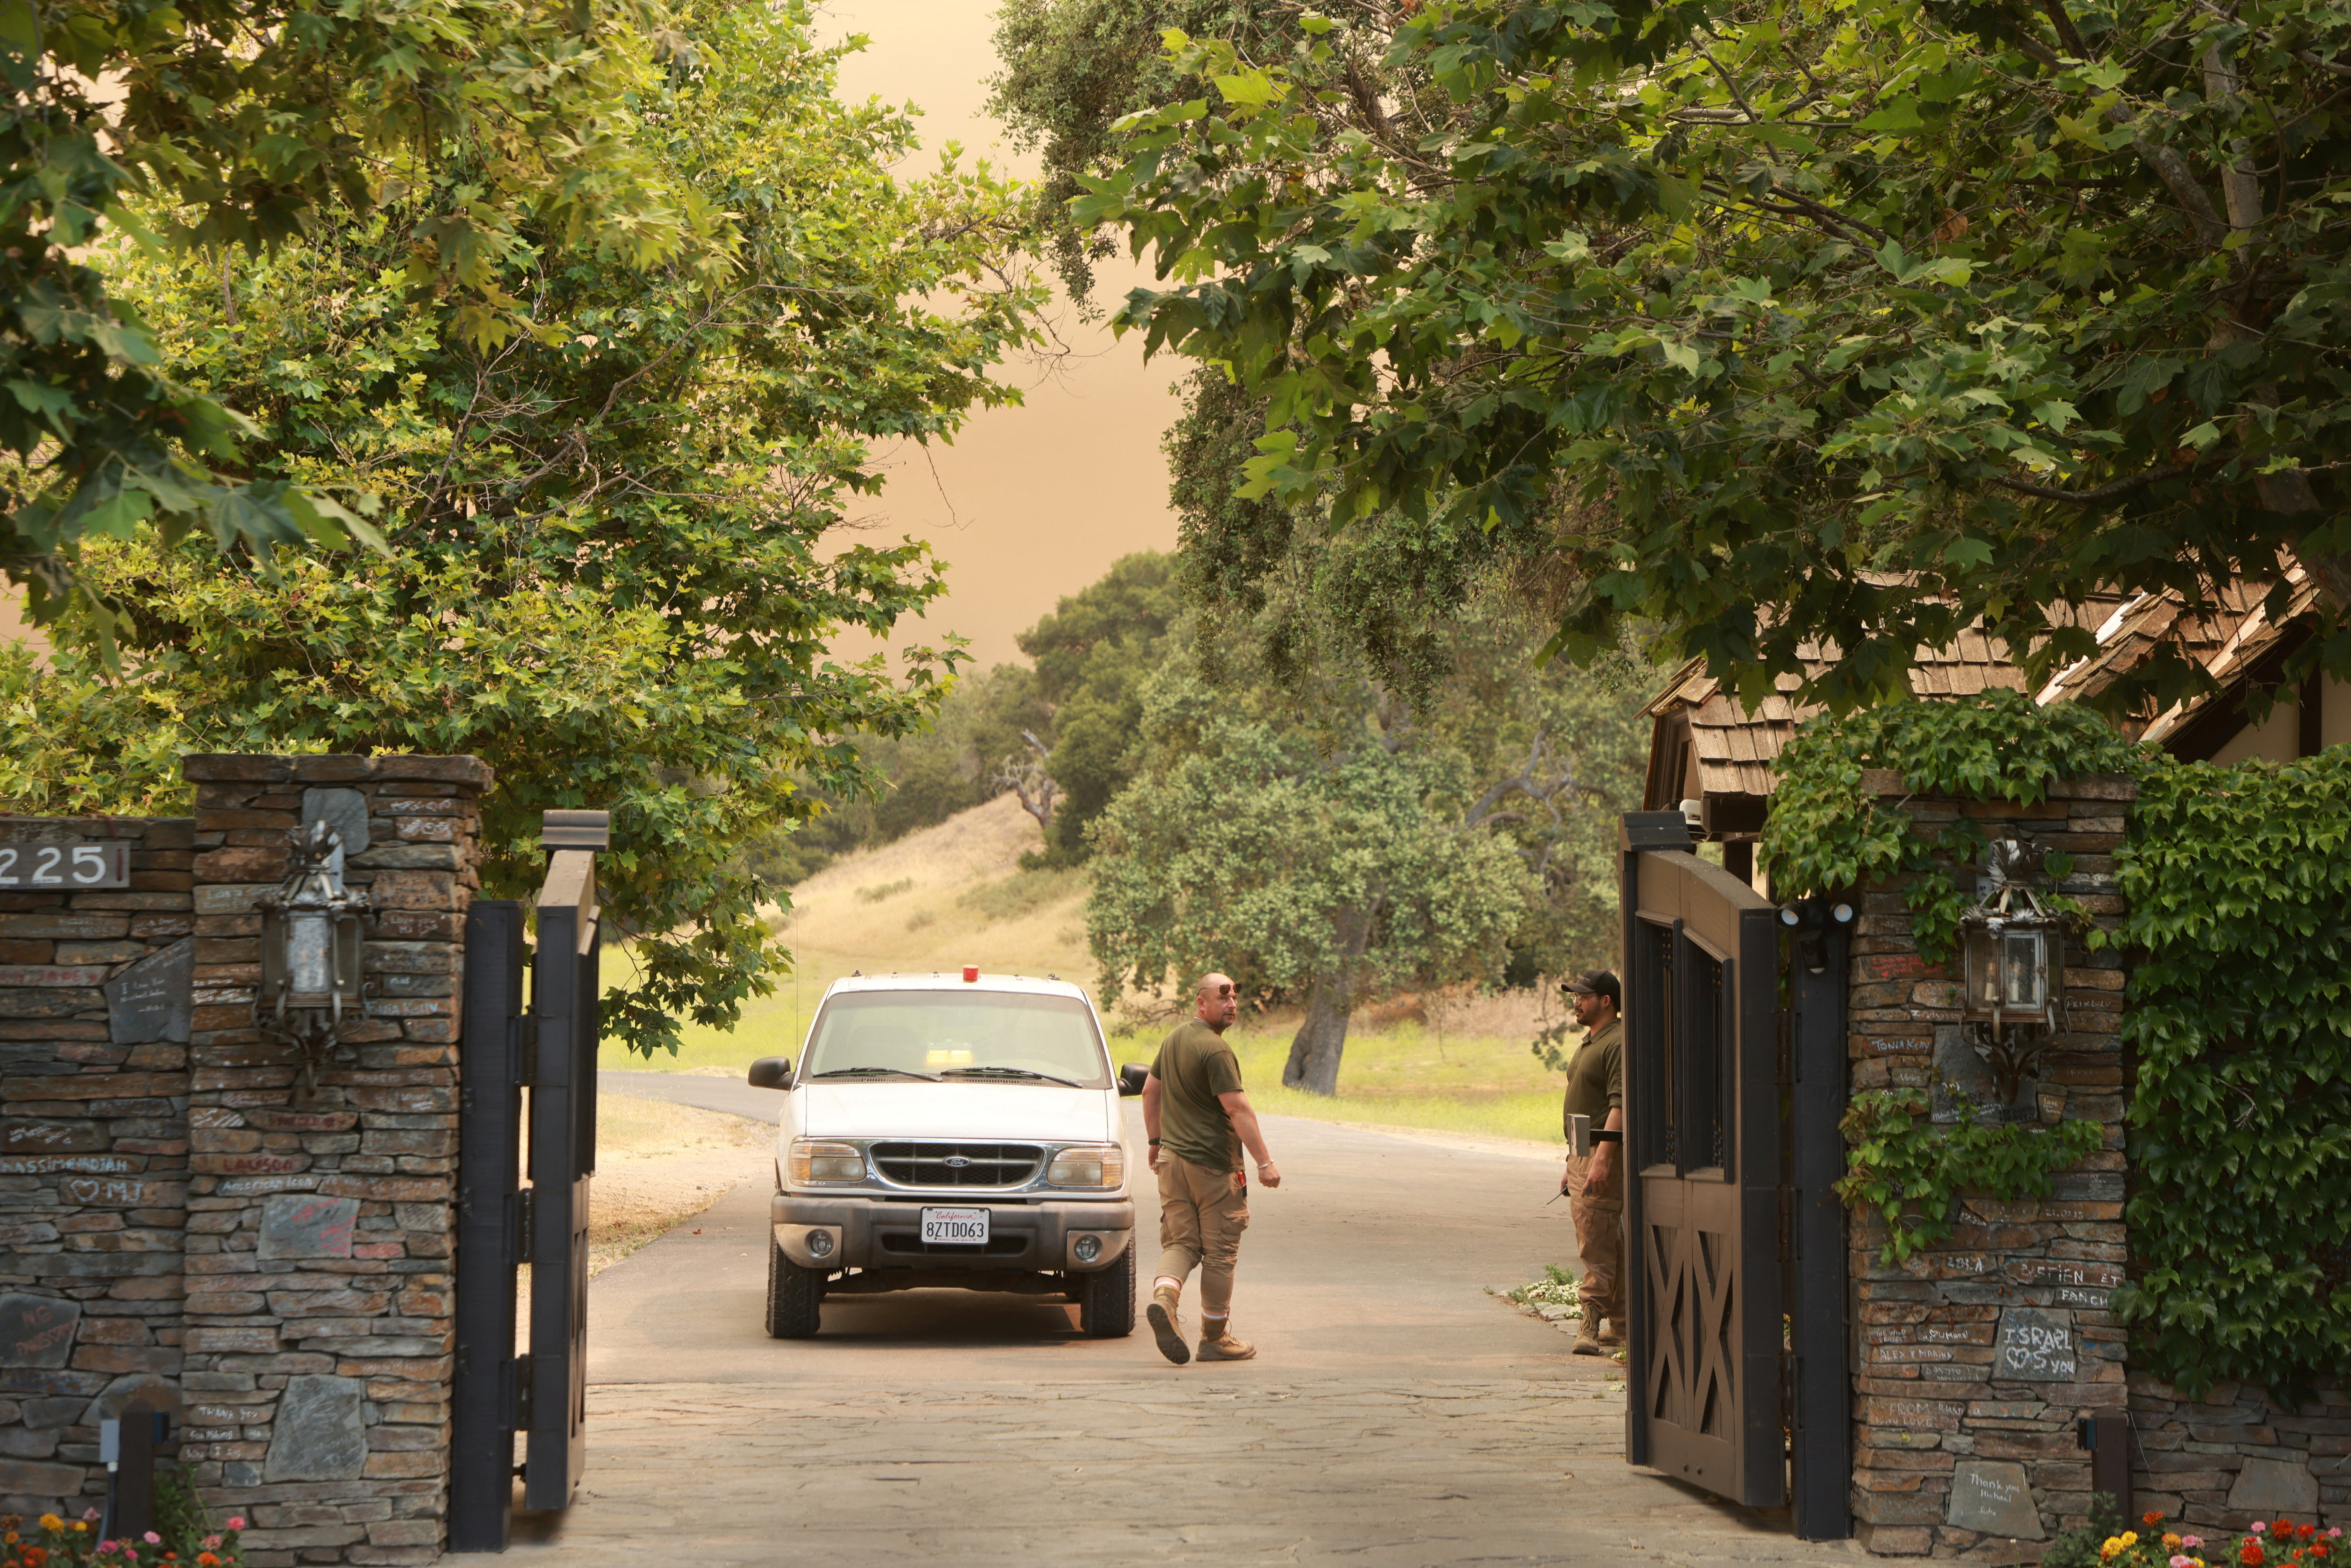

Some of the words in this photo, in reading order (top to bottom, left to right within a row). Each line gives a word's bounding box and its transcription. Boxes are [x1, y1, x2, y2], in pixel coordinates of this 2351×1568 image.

[106, 1182, 144, 1202] MJ
[936, 1211, 976, 1221] California
[927, 1222, 984, 1238] 8ZTD063
[2101, 1273, 2121, 1286] ET
[1880, 1349, 1905, 1360] ALEX
[1890, 1403, 1930, 1415] FROM
[1970, 1473, 2003, 1490] Thank
[1980, 1489, 2011, 1503] Michael
